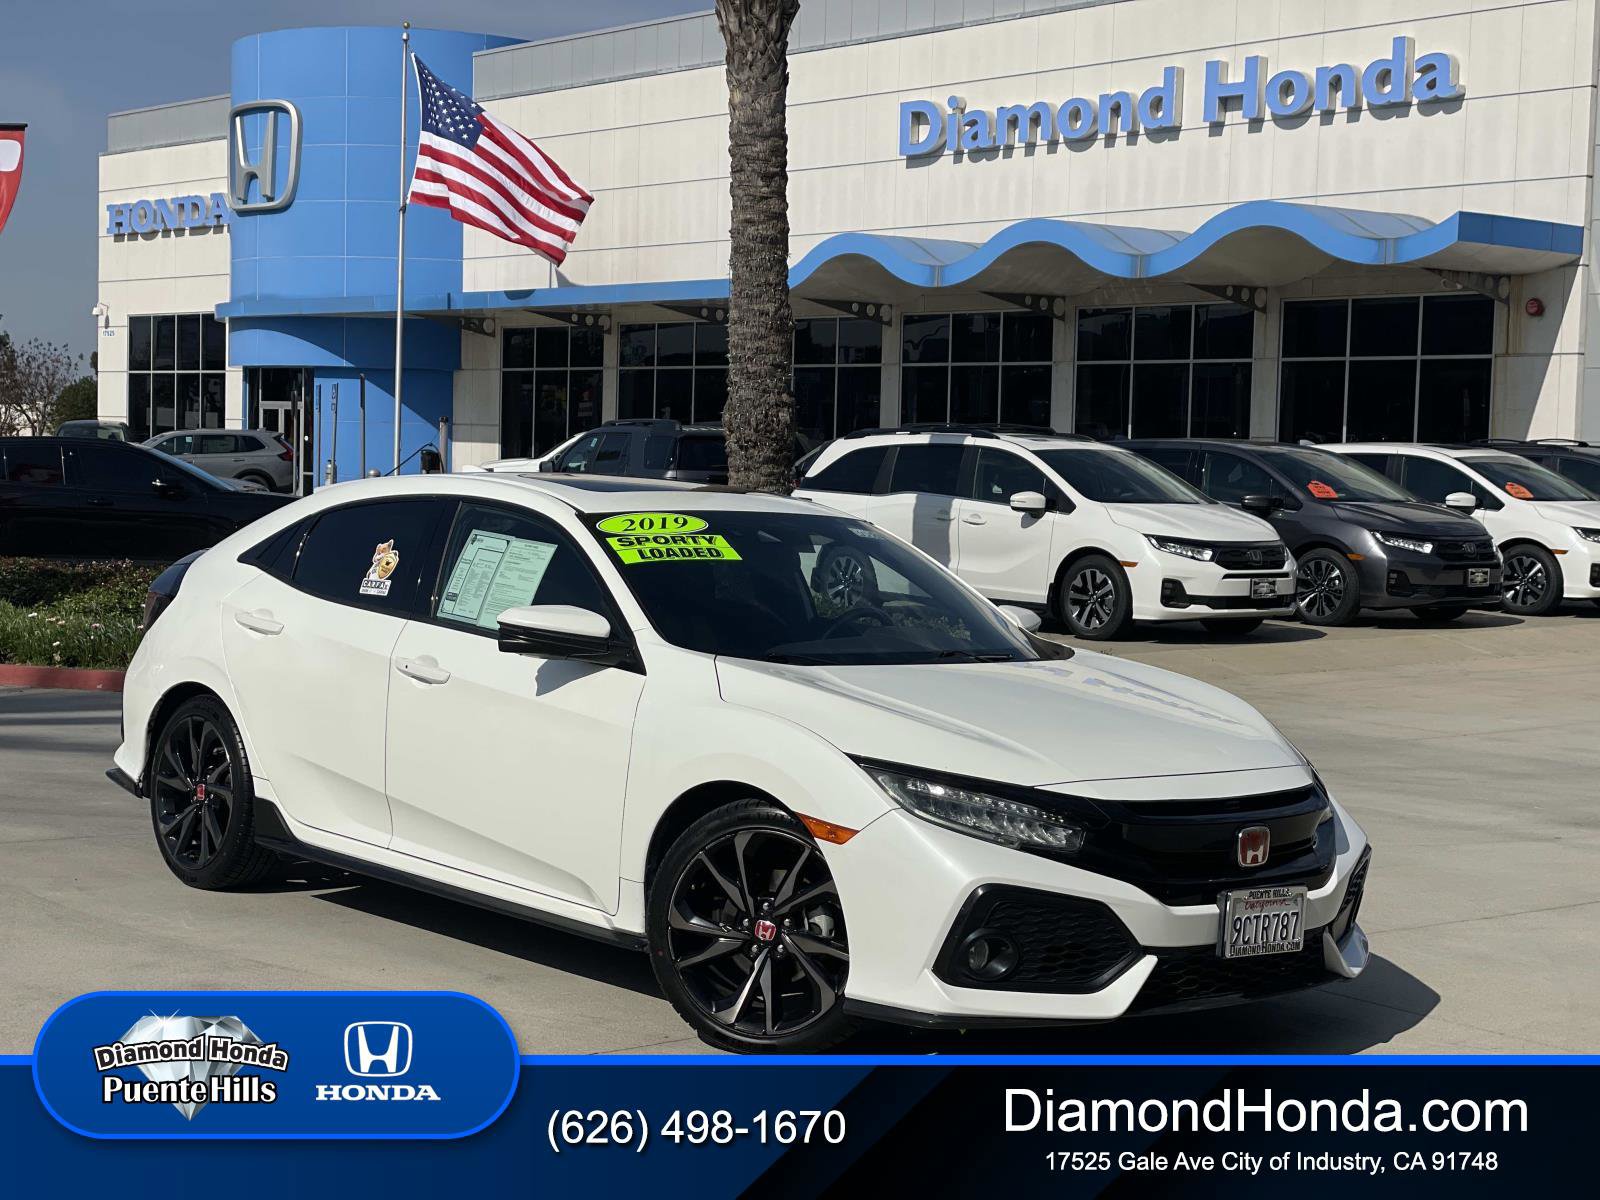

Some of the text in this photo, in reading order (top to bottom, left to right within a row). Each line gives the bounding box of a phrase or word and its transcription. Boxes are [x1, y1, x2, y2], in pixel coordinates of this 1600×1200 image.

[900, 37, 1464, 156] Diamond Honda
[106, 193, 232, 234] HONDA
[621, 516, 689, 532] 2019
[616, 535, 717, 547] SPORTY
[637, 547, 724, 560] LOADED
[1249, 889, 1272, 899] PUENTE
[1232, 911, 1299, 945] 9CTR787
